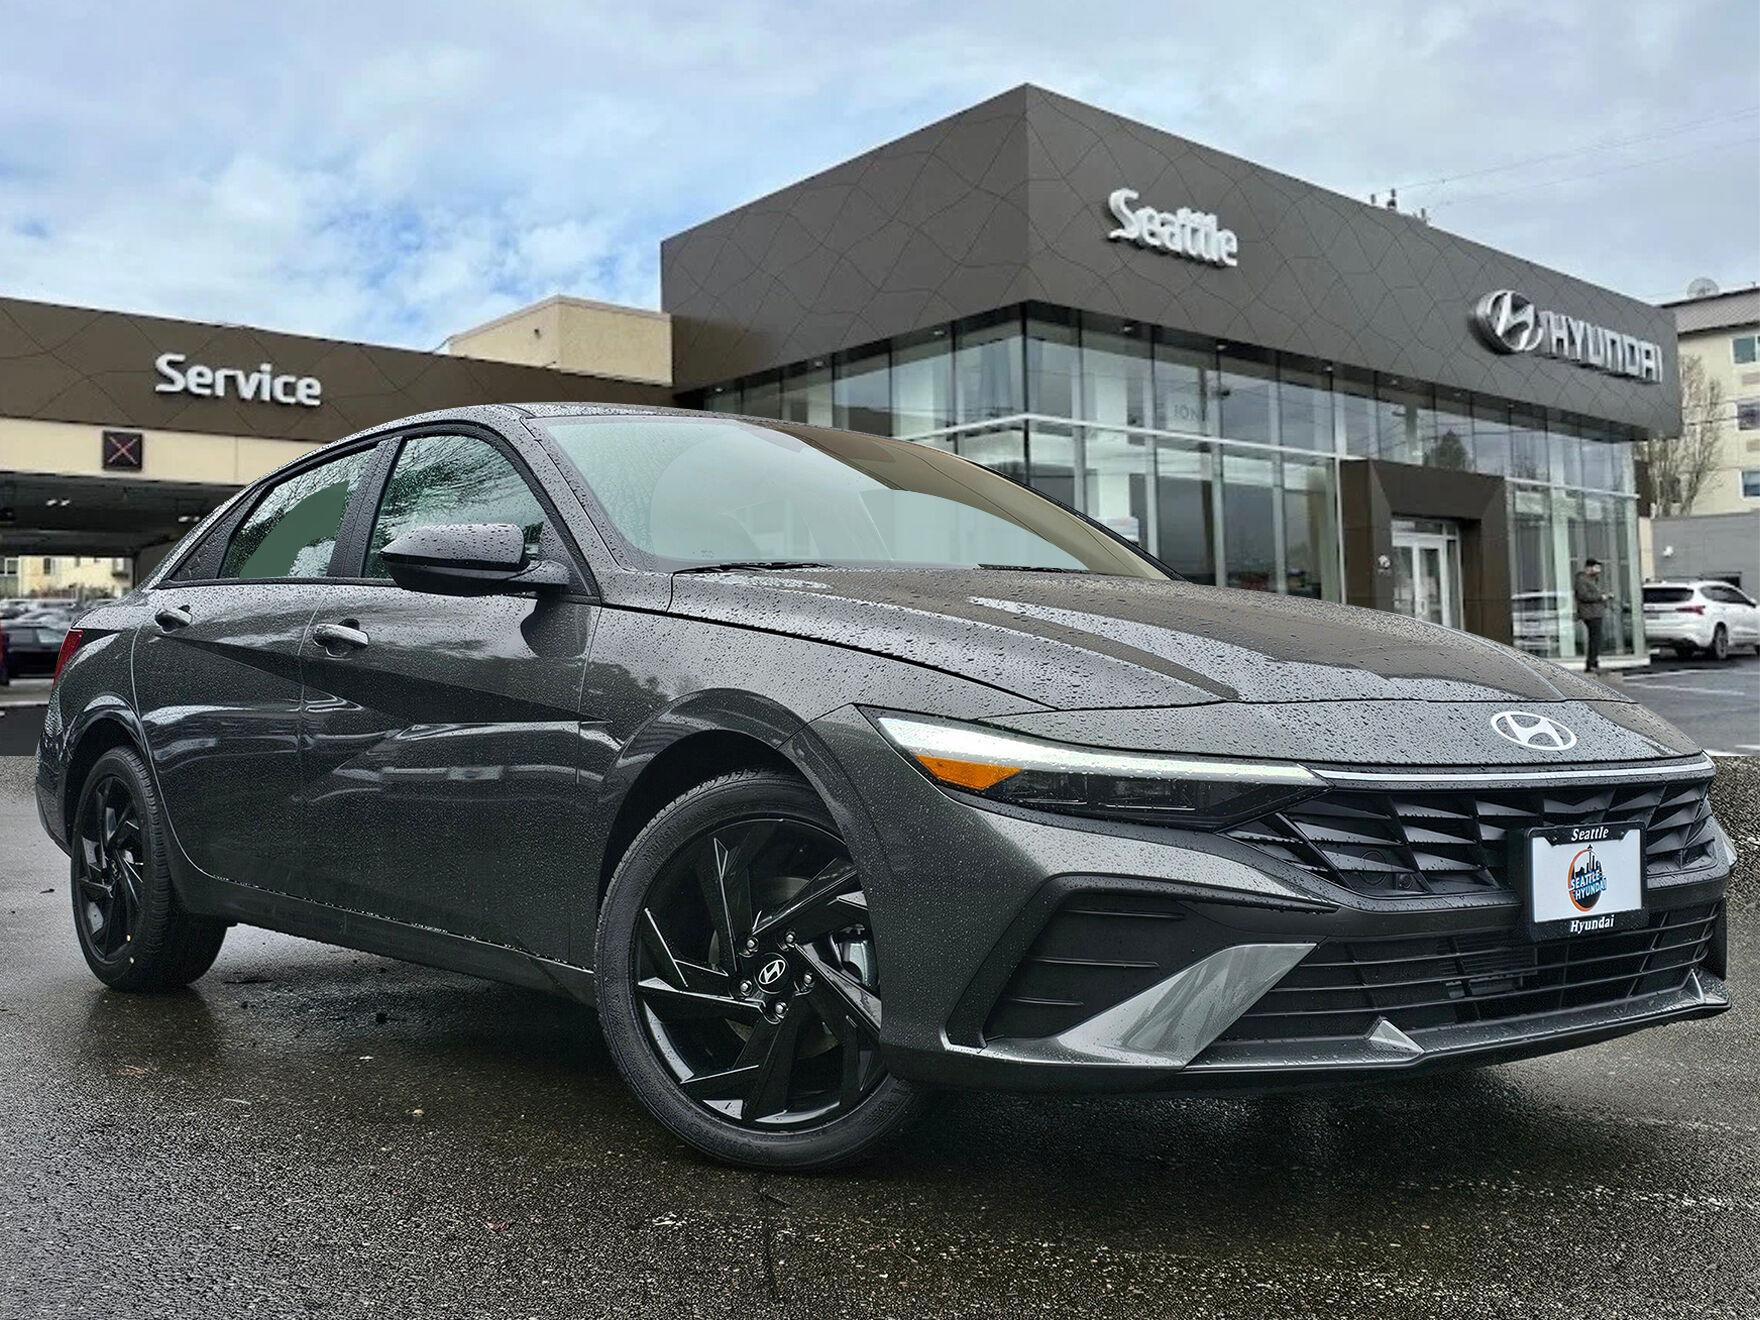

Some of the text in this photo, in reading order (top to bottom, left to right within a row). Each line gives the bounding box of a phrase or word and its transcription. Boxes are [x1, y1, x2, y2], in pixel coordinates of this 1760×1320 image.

[1109, 188, 1238, 267] Seattle
[1540, 311, 1663, 382] HYUNDAI
[155, 353, 322, 407] Service
[1571, 826, 1609, 842] Seattle
[1570, 870, 1602, 890] SEATTLE
[1570, 915, 1615, 934] Hyundai
